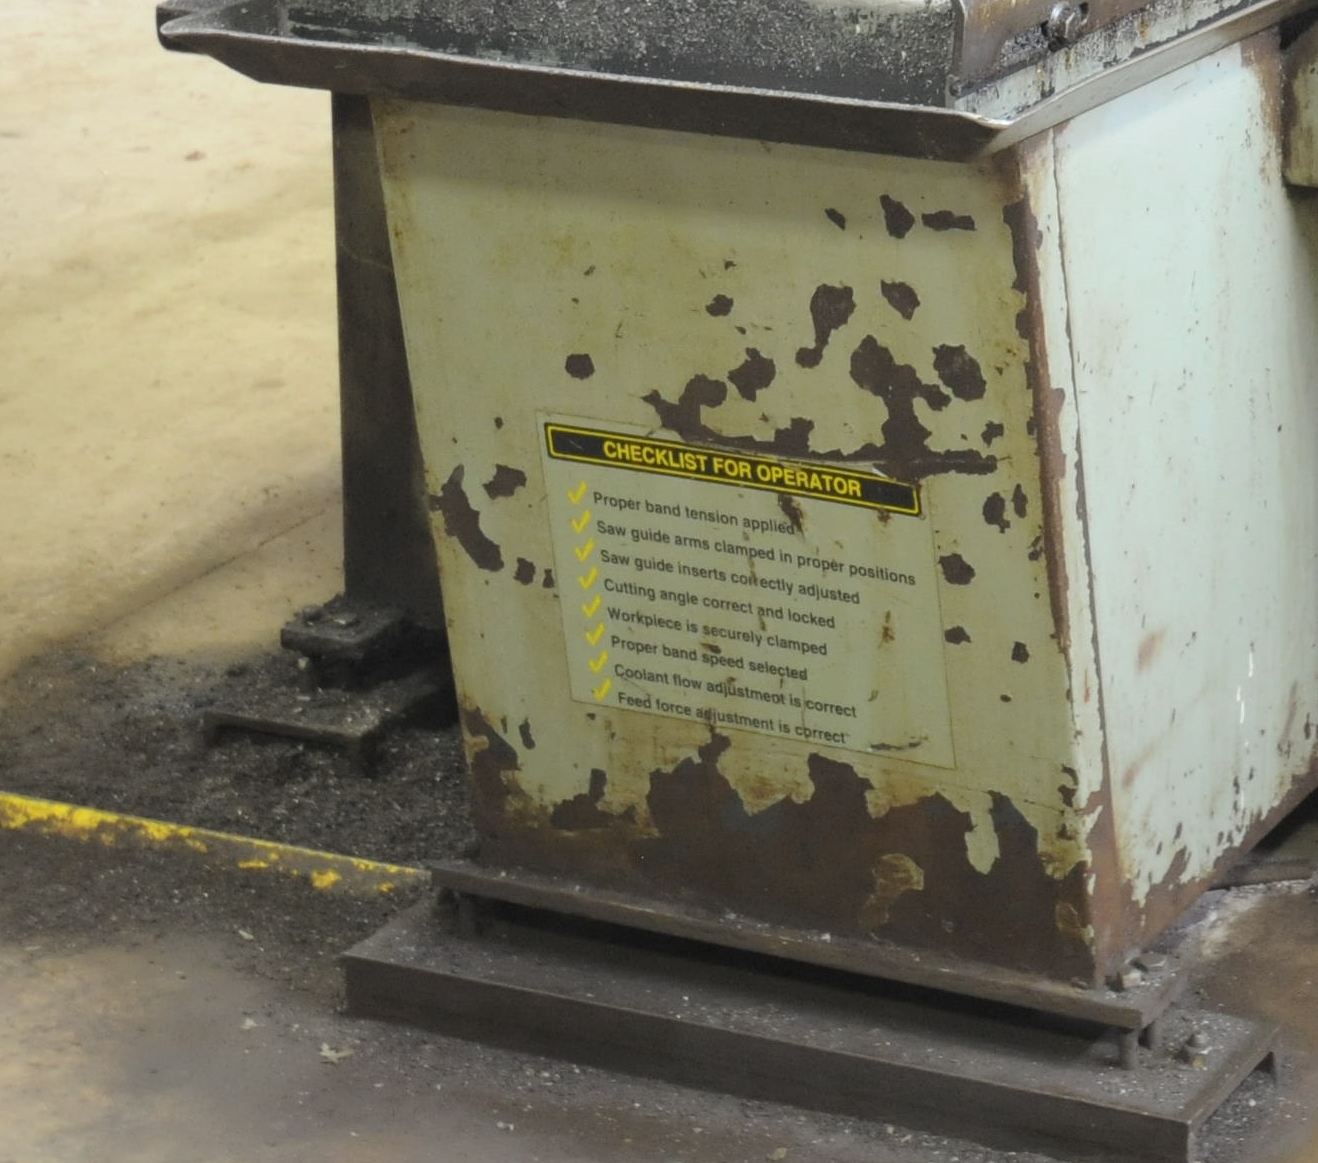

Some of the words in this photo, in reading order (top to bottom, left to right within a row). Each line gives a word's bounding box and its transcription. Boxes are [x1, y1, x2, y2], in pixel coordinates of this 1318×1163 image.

[603, 440, 708, 472] CHECKLIST
[713, 459, 752, 480] FOR
[757, 466, 862, 498] OPERATOR
[593, 492, 640, 513] Proper
[646, 498, 680, 517] band
[685, 508, 738, 526] tension
[743, 515, 796, 536] applied
[596, 520, 626, 538] Saw
[632, 526, 670, 546] guide
[675, 534, 710, 551] arms
[714, 539, 775, 564] clamped
[780, 549, 792, 564] in
[797, 554, 844, 576] proper
[849, 560, 916, 586] positions
[600, 549, 630, 566] Saw
[635, 554, 674, 575] guide
[678, 562, 727, 583] inserts
[798, 580, 860, 605] adjusted
[604, 578, 656, 601] Cutting
[660, 588, 698, 608] angle
[702, 595, 754, 616] correct
[758, 603, 784, 620] and
[788, 608, 836, 630] locked
[607, 606, 682, 632] Workpiece
[686, 618, 698, 634] is
[702, 622, 763, 648] securely
[767, 634, 828, 658] clamped
[610, 636, 658, 656] Proper
[662, 643, 698, 662] band
[702, 652, 744, 672] speed
[749, 656, 808, 681] selected
[614, 664, 669, 685] Coolant
[673, 672, 702, 690] flow
[706, 678, 786, 705] adjustment
[789, 692, 802, 708] is
[806, 698, 857, 718] correct
[618, 692, 651, 710] Feed
[655, 698, 692, 716] force
[695, 706, 774, 732] adjustment
[778, 718, 791, 734] is
[795, 724, 847, 744] correct
